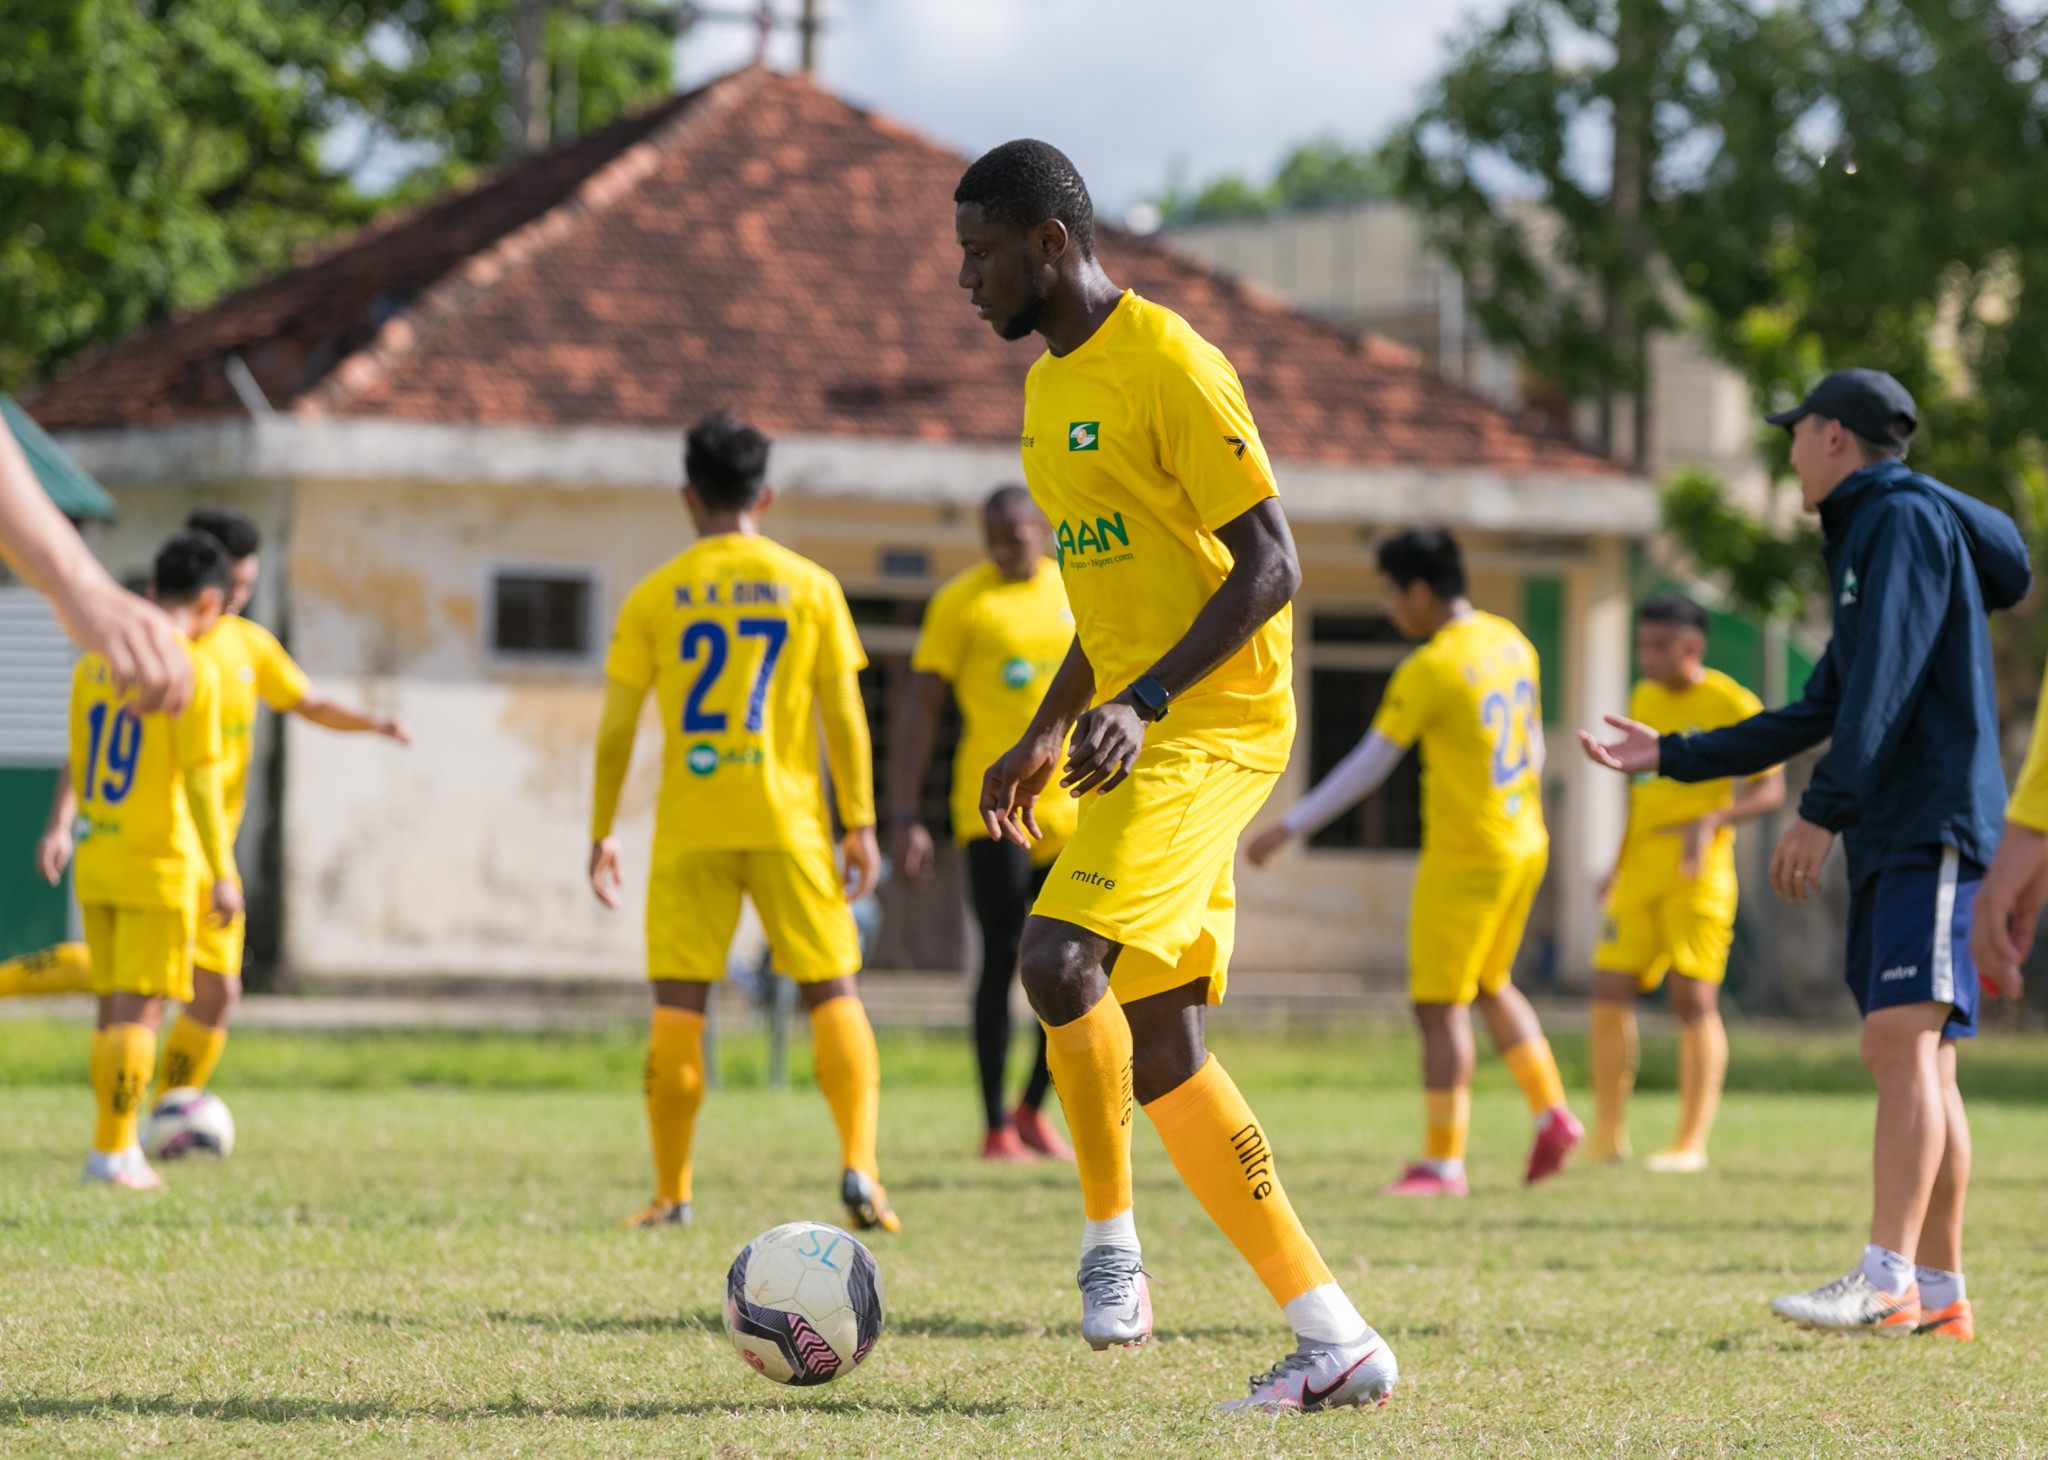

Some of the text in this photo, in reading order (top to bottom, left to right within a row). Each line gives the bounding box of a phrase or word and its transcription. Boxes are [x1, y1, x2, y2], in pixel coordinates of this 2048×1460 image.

[1091, 557, 1114, 568] Ngon
[681, 618, 788, 733] 27
[84, 702, 144, 804] 19
[1070, 869, 1117, 890] mitre
[1880, 964, 1918, 983] mitre
[1230, 1123, 1272, 1201] mitre
[797, 1229, 841, 1272] SL
